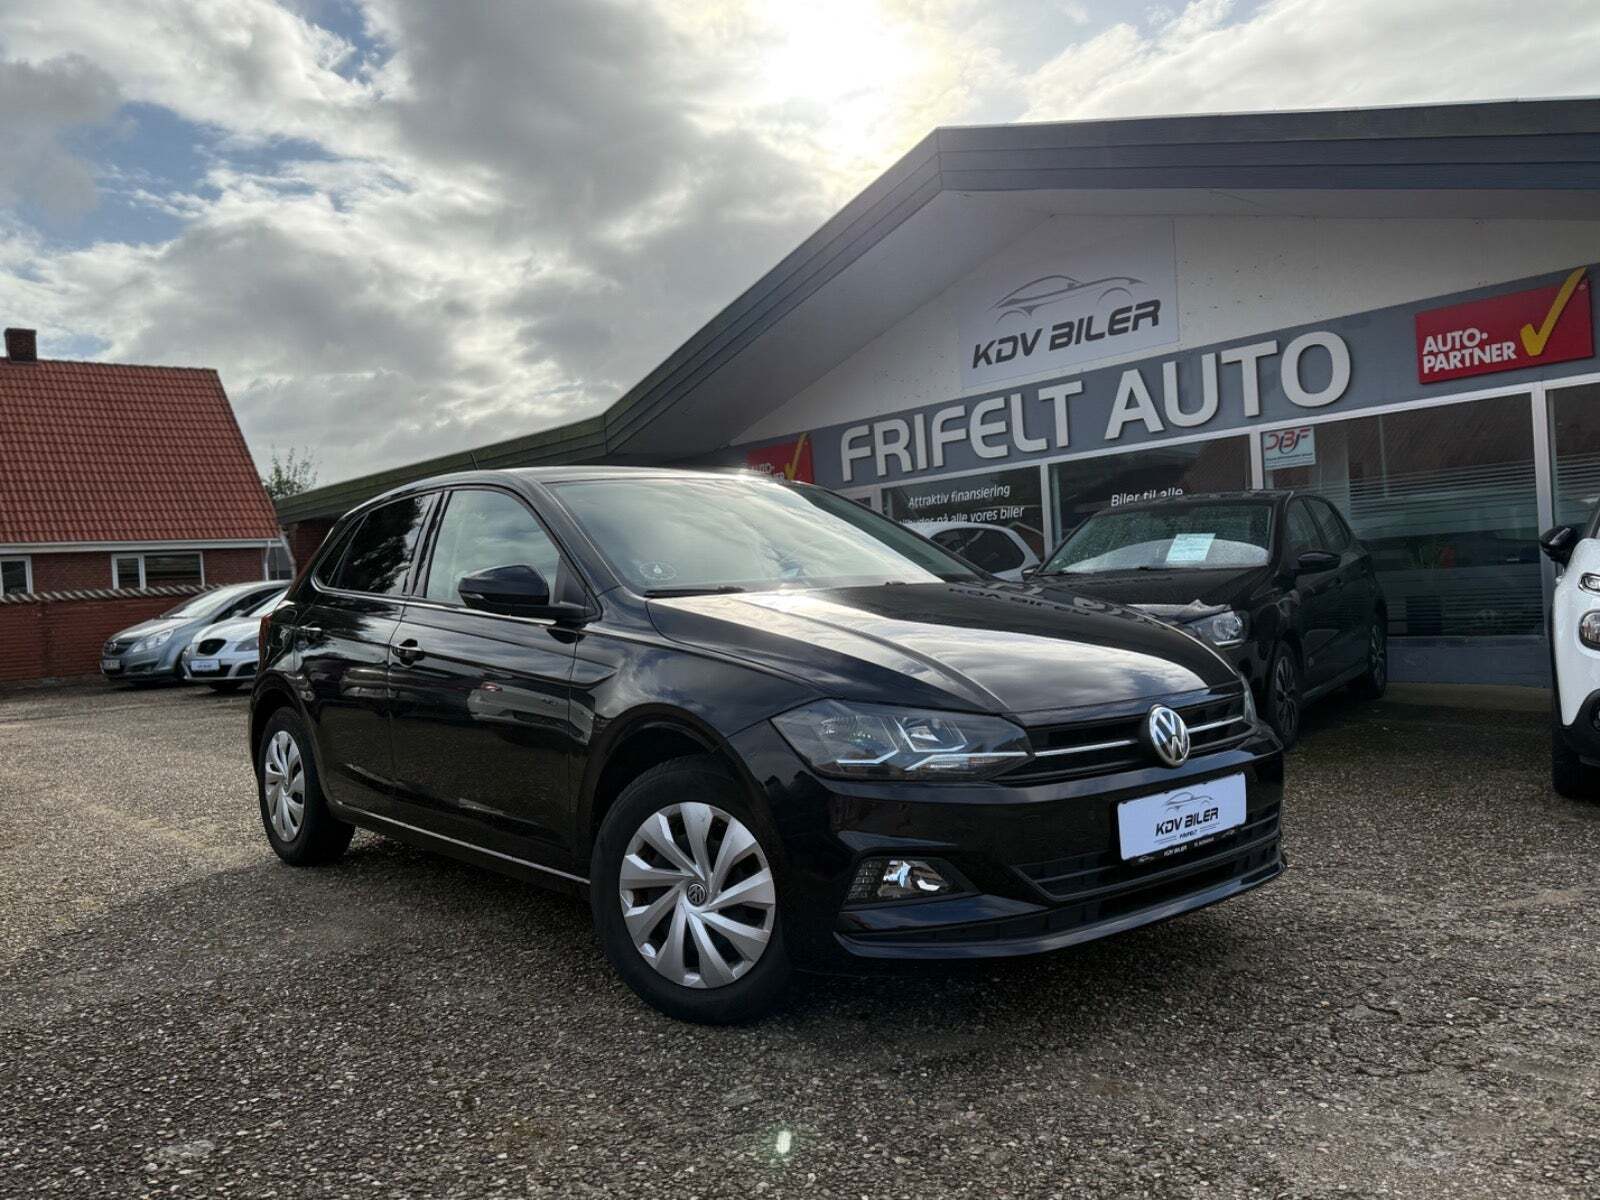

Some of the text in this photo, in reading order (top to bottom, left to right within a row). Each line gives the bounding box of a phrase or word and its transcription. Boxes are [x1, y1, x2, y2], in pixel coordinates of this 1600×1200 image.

[972, 299, 1161, 369] KDV BILER
[1423, 341, 1518, 374] PARTNER
[840, 331, 1352, 482] FRIFELT AUTO
[908, 484, 1011, 509] Attraktiv finansiering
[1111, 493, 1140, 507] Biler
[970, 510, 998, 522] vores
[1000, 505, 1025, 520] biler
[1155, 807, 1219, 837] KDV BILER
